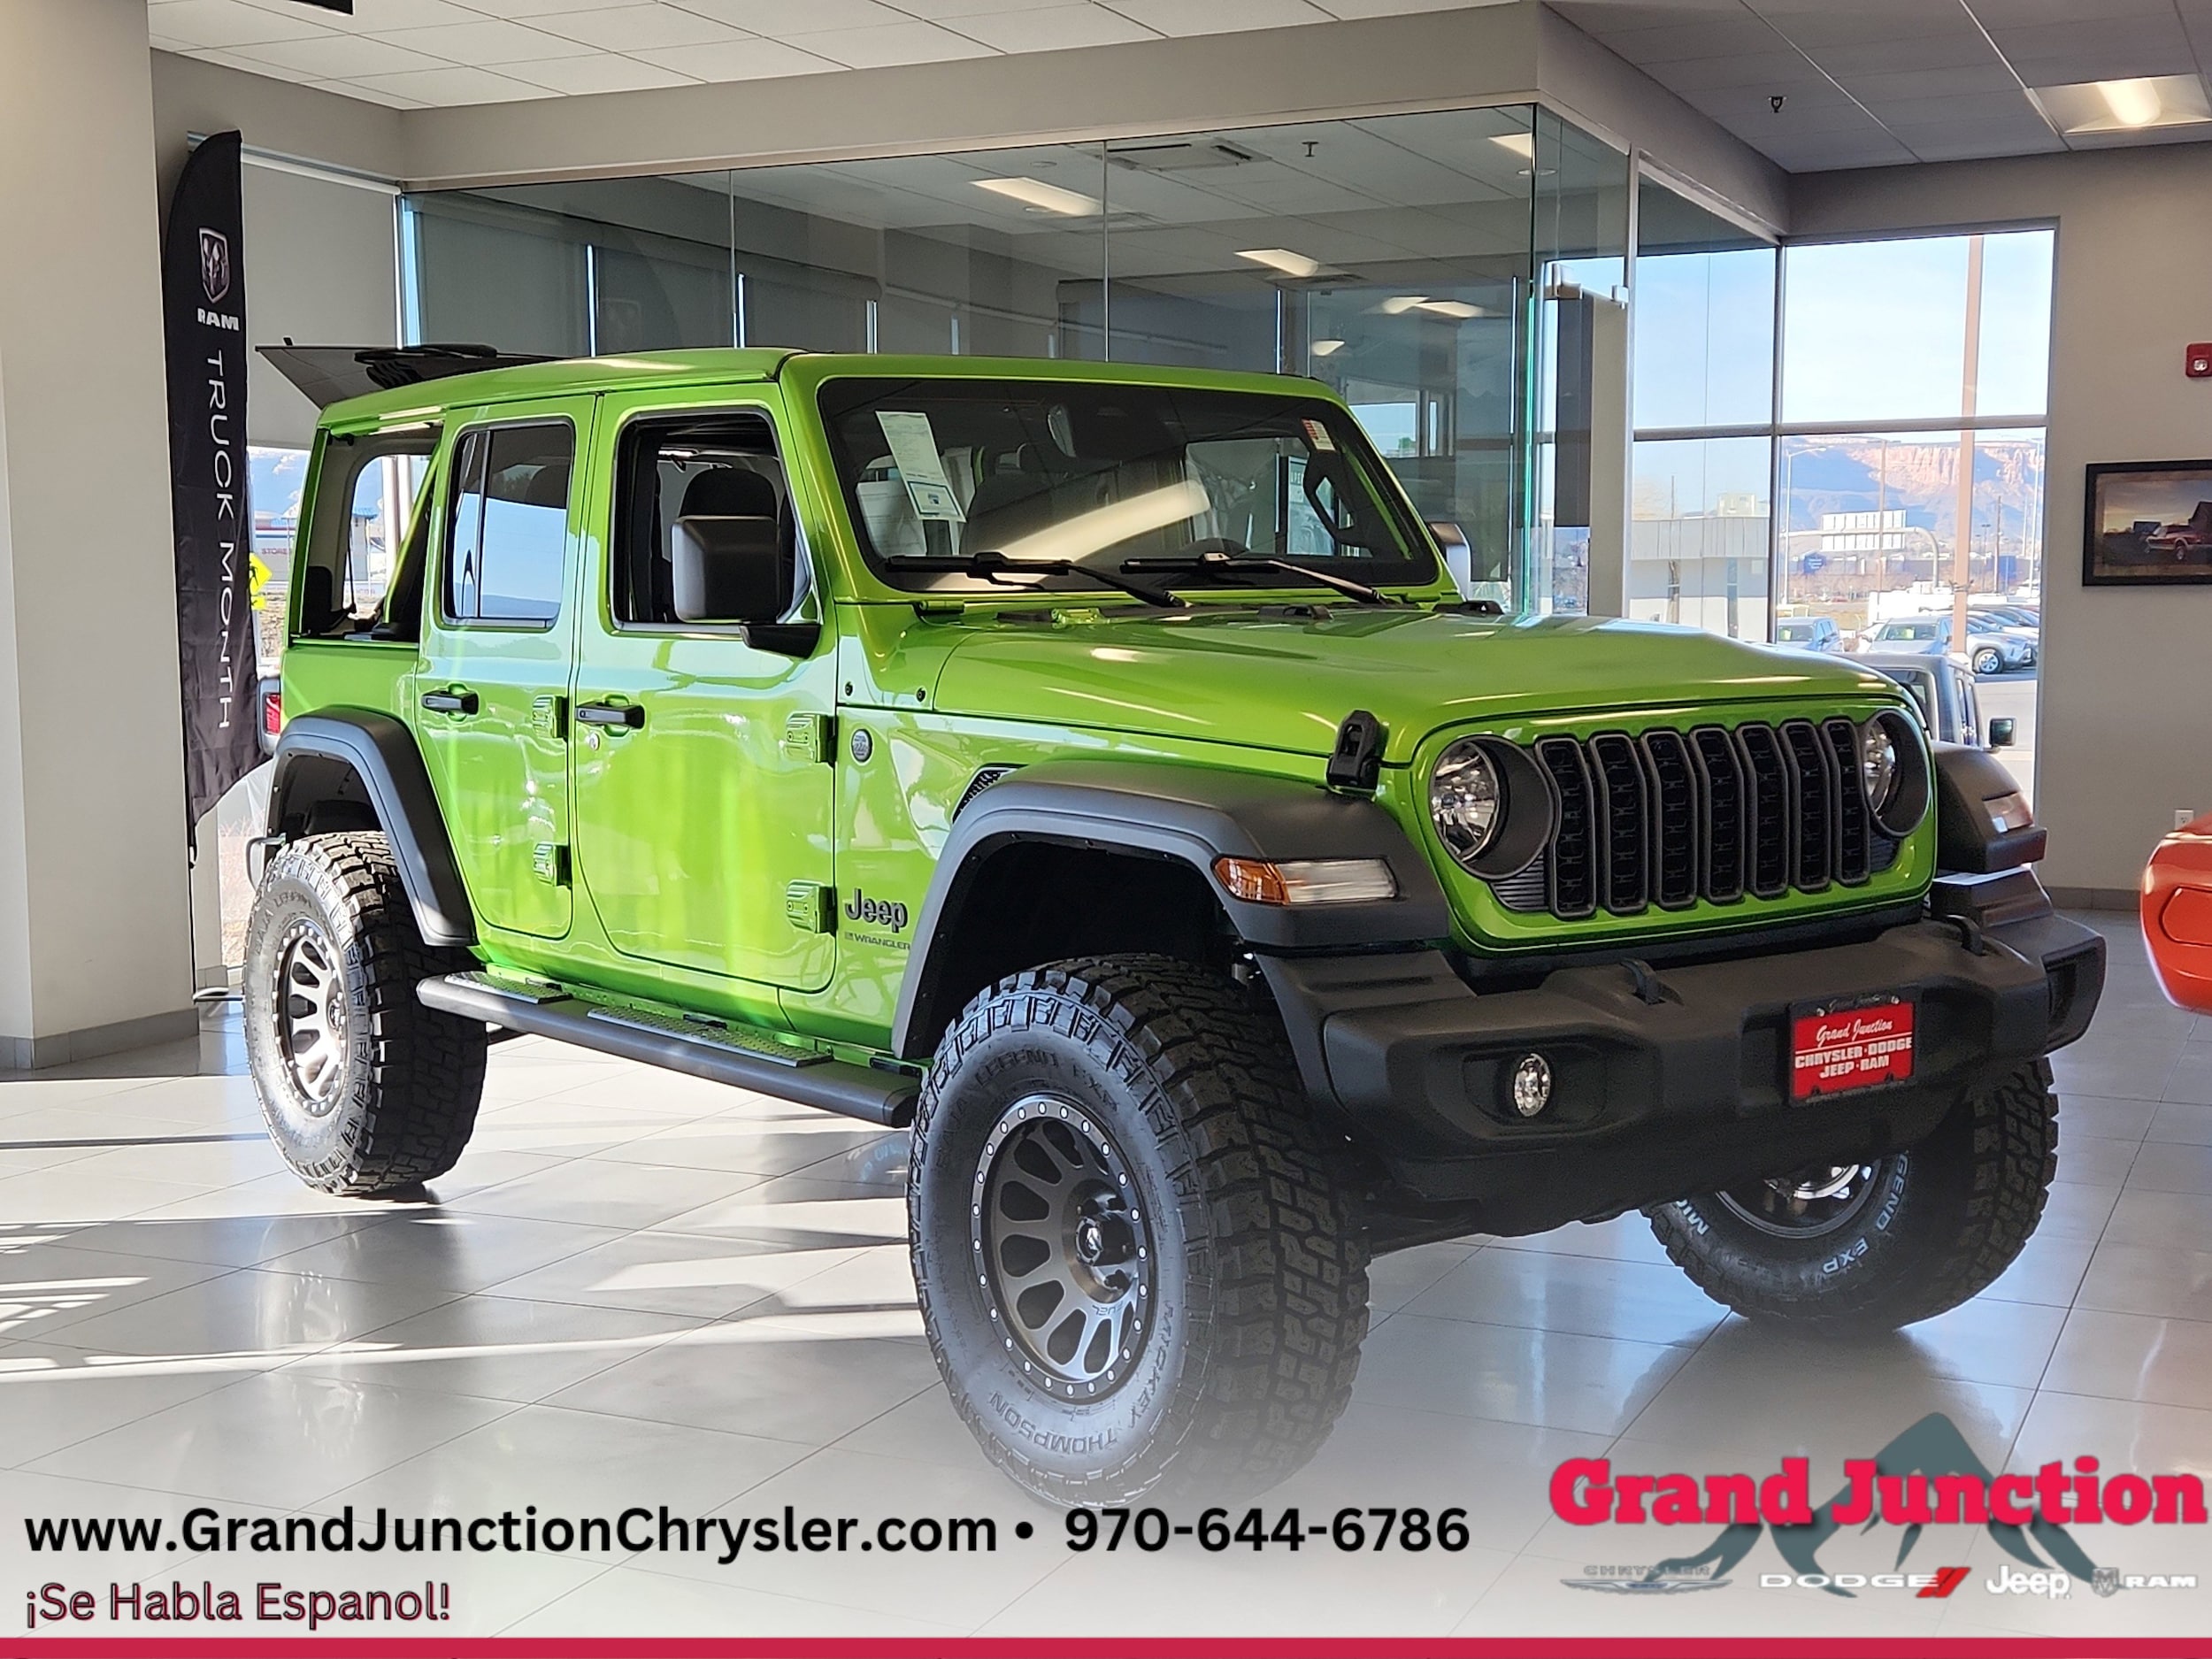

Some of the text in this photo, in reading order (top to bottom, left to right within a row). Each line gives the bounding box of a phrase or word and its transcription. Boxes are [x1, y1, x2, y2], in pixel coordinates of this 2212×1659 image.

[197, 307, 240, 332] RAM
[207, 349, 234, 729] TRUCK MONTH
[844, 887, 909, 933] Jeep
[854, 933, 911, 951] WRANGLER
[1816, 1018, 1893, 1048] Grand Junction
[1821, 1236, 1870, 1274] EXP
[988, 1299, 1174, 1455] MICKEY THOMPSON
